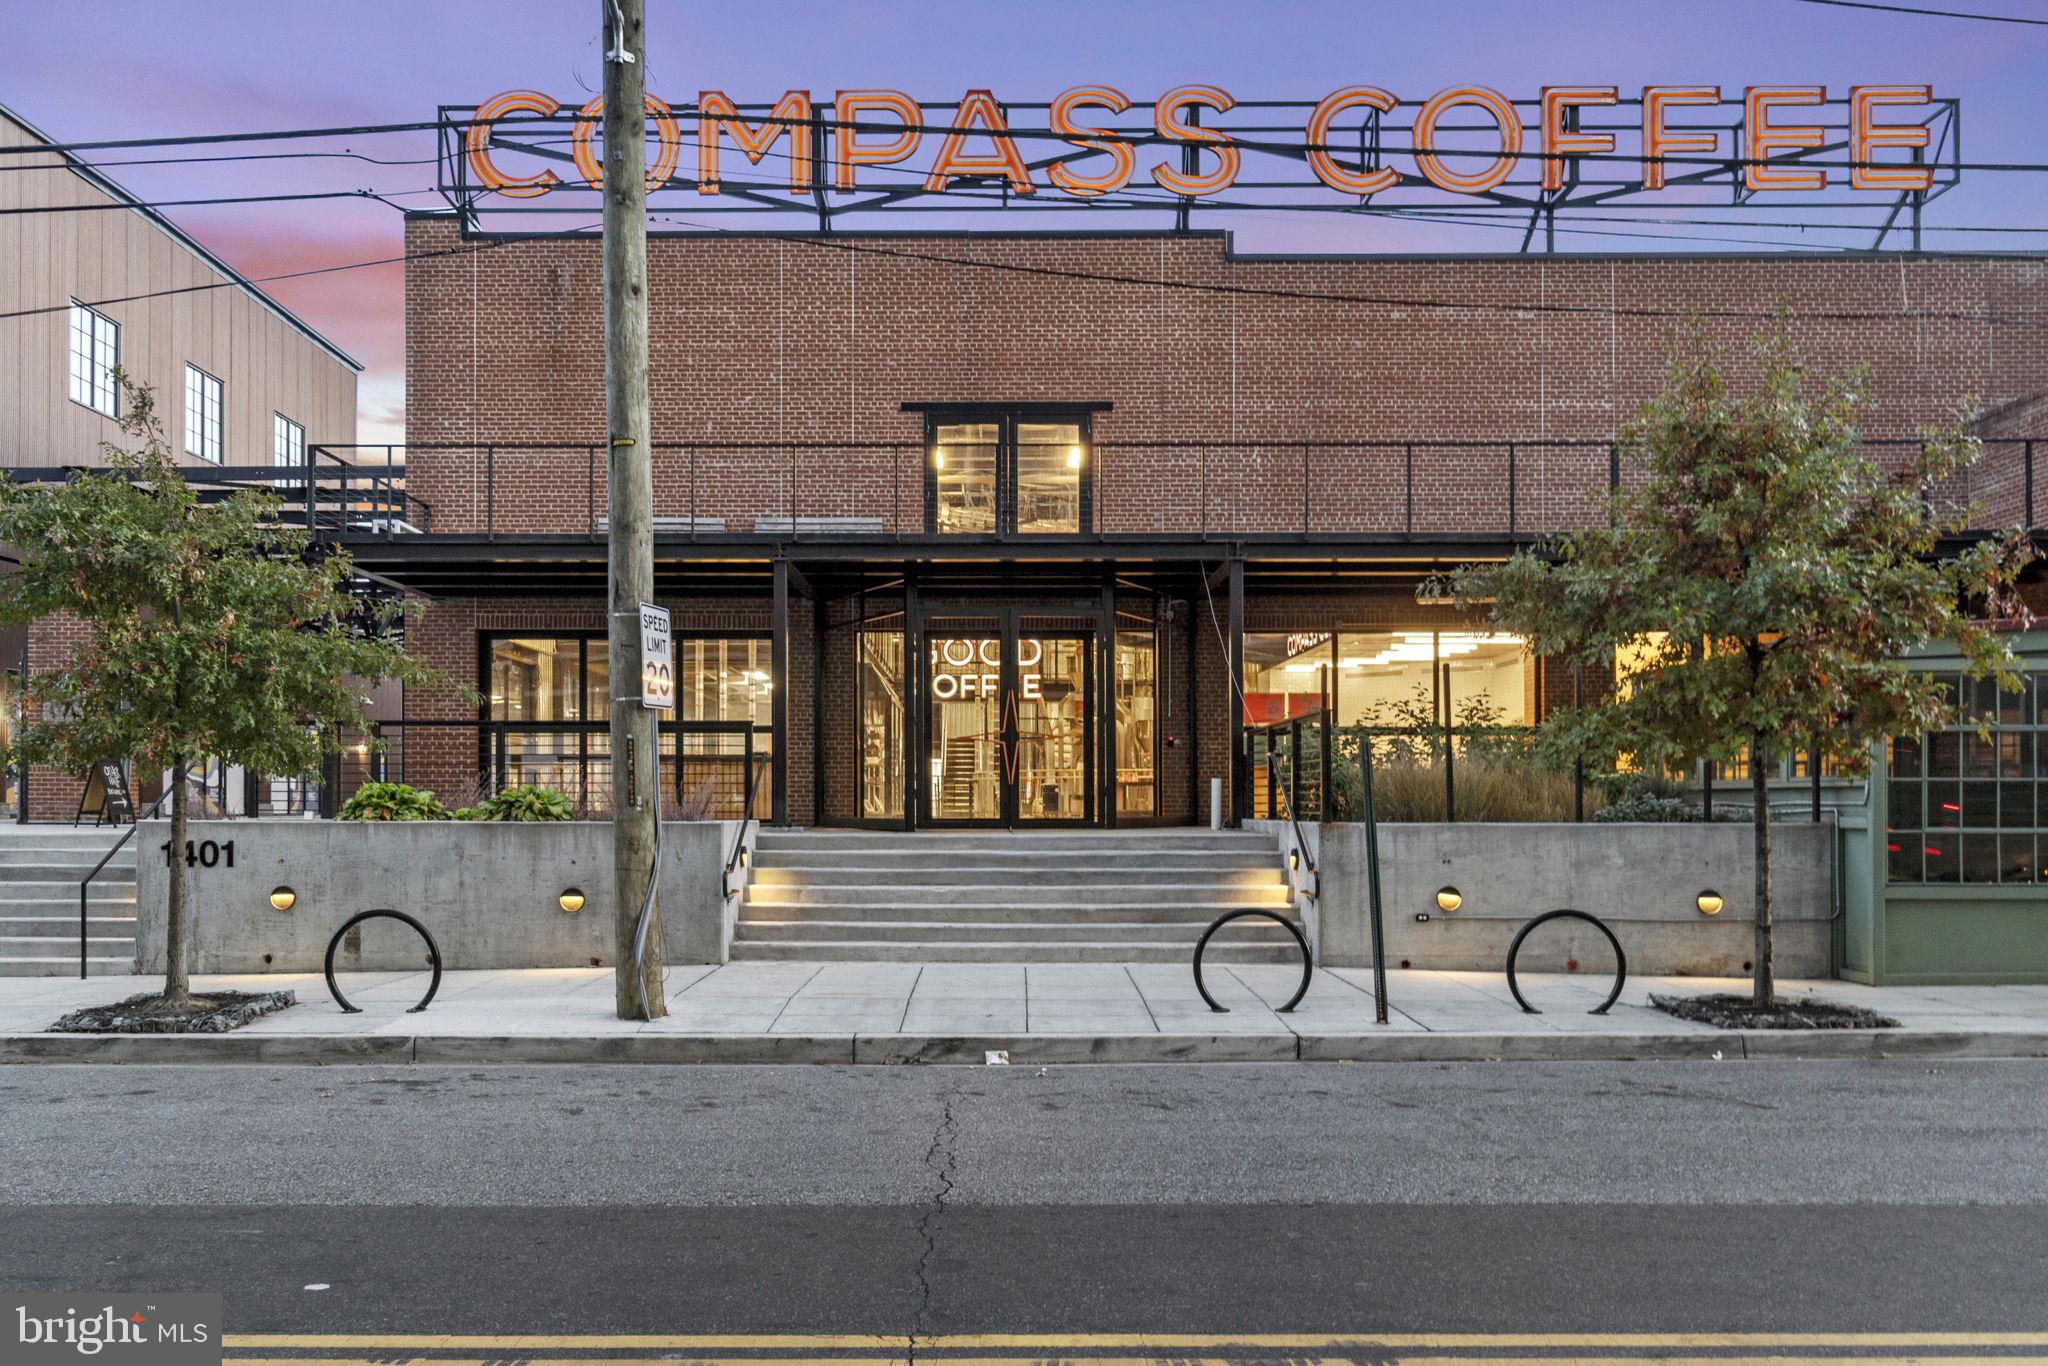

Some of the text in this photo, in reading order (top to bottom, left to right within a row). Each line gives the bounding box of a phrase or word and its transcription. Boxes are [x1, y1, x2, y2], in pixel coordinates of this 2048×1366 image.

[465, 84, 1934, 198] COMPASS COFFEE
[643, 613, 668, 633] SPEED
[646, 636, 667, 655] LIMIT
[646, 661, 669, 697] 20
[161, 840, 235, 868] 1401
